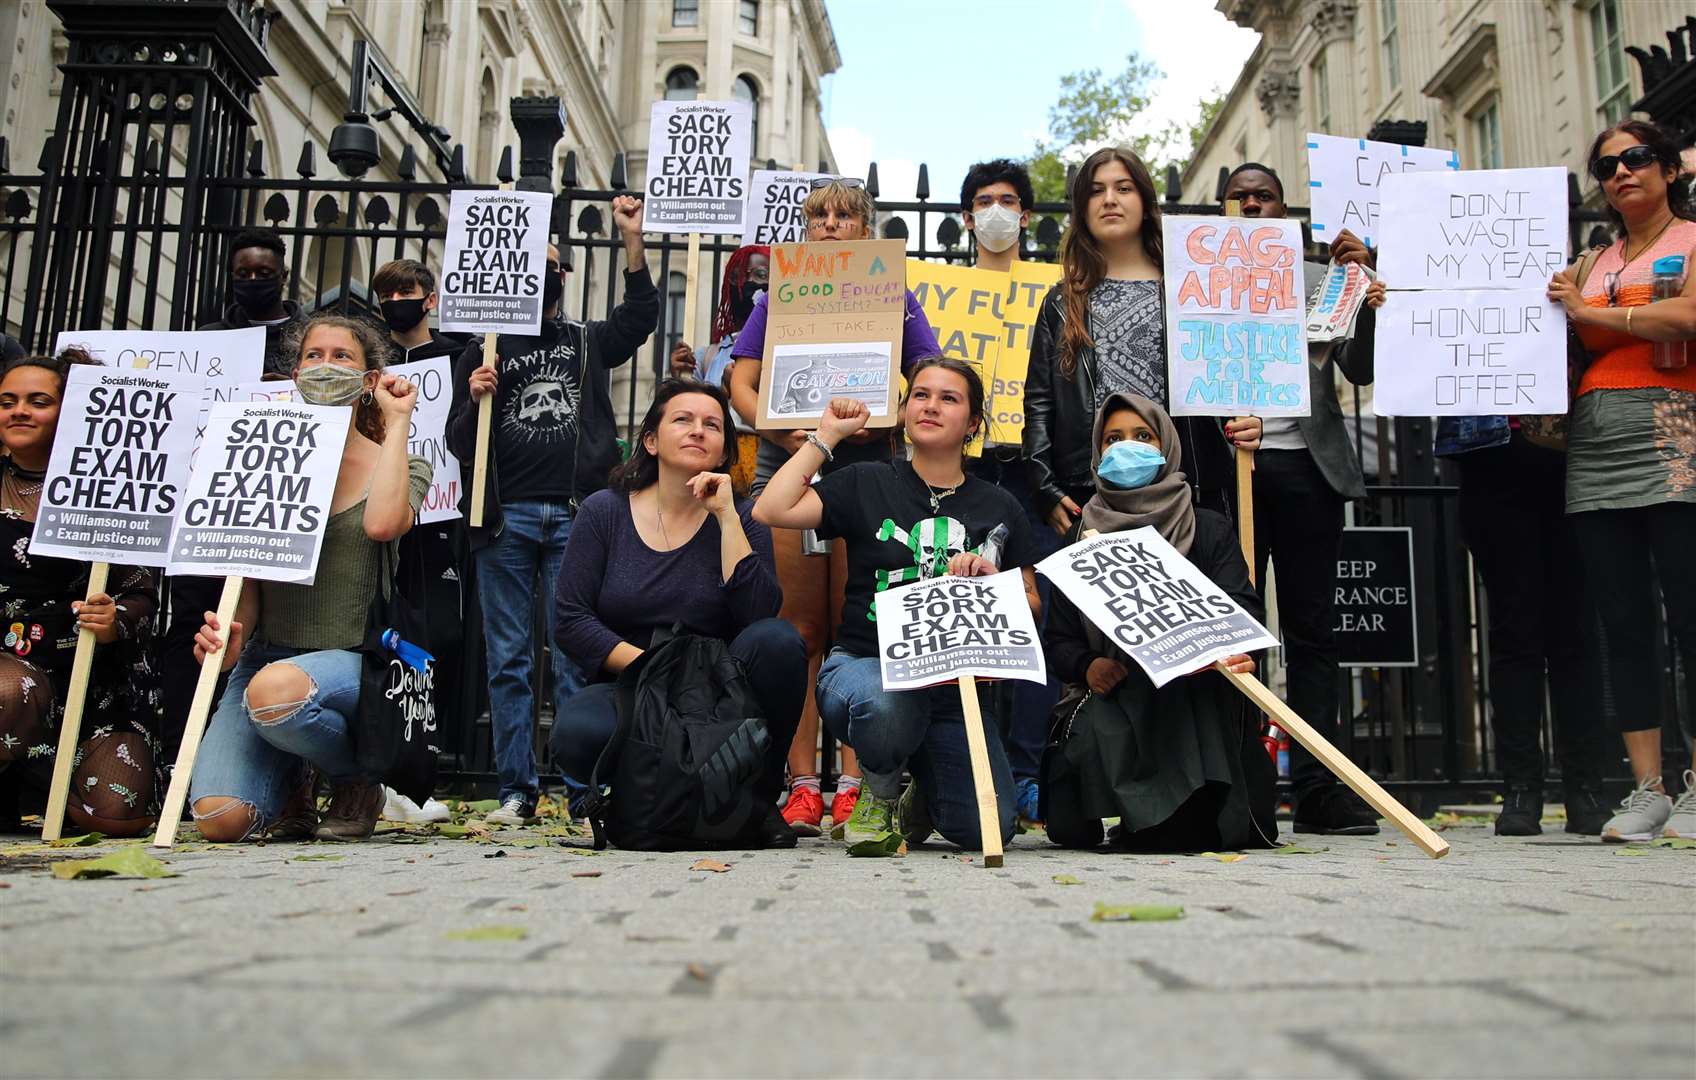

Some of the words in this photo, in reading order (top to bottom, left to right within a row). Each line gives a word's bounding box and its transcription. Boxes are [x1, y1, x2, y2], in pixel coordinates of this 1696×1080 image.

[667, 114, 732, 135] SACK
[668, 135, 730, 155] TORY
[662, 156, 732, 176] EXAM
[649, 177, 743, 198] CHEATS
[765, 185, 808, 205] SAC
[474, 196, 501, 204] Socialist
[501, 196, 525, 204] Worker
[660, 201, 709, 210] Williamson
[710, 202, 726, 210] out
[1450, 190, 1530, 218] DON'T
[465, 205, 531, 227] SACK
[660, 211, 684, 220] Exam
[685, 211, 716, 221] justice
[763, 205, 802, 226] TOR
[465, 227, 528, 249] TORY
[1440, 218, 1550, 248] WASTE
[458, 250, 529, 272] EXAM
[775, 246, 854, 279] WANT
[868, 256, 887, 276] A
[1427, 254, 1468, 280] MY
[1481, 252, 1562, 280] YEAR
[445, 272, 539, 296] CHEATS
[778, 283, 833, 303] GOOD
[1178, 266, 1297, 314] APPEAL
[455, 298, 505, 308] Williamson
[505, 300, 521, 308] out
[455, 310, 479, 318] Exam
[479, 310, 511, 320] justice
[512, 312, 531, 320] now
[1412, 306, 1542, 338] HONOUR
[776, 323, 816, 340] JUST
[1179, 320, 1302, 364] JUSTICE
[1445, 343, 1507, 367] THE
[206, 357, 223, 377] &
[1207, 360, 1265, 384] FOR
[101, 375, 137, 387] Socialist
[137, 378, 170, 389] Worker
[1185, 377, 1301, 407] MEDICS
[1436, 374, 1536, 405] OFFER
[85, 387, 177, 421] SACK
[243, 409, 280, 418] Socialist
[281, 409, 314, 419] Worker
[85, 417, 170, 450] TORY
[227, 418, 320, 448] SACK
[69, 447, 168, 482] EXAM
[225, 445, 313, 474] TORY
[48, 476, 177, 513] CHEATS
[207, 472, 311, 503] EXAM
[60, 512, 129, 529] Williamson
[130, 518, 150, 530] out
[184, 499, 320, 532] CHEATS
[57, 528, 91, 541] Exam
[91, 531, 135, 545] justice
[136, 535, 161, 547] now
[196, 532, 266, 545] Williamson
[269, 536, 292, 548] out
[1068, 541, 1104, 560] Socialist
[1103, 536, 1130, 547] Worker
[192, 546, 227, 559] Exam
[228, 546, 274, 561] justice
[276, 553, 304, 563] now
[1070, 542, 1160, 581] SACK
[1088, 560, 1172, 598] TORY
[1336, 560, 1377, 578] EEP
[902, 584, 998, 607] SACK
[910, 580, 949, 591] Socialist
[1334, 587, 1408, 605] RANCE
[905, 599, 997, 621] TORY
[1104, 579, 1202, 622] EXAM
[901, 614, 1009, 641] EXAM
[1113, 595, 1235, 646] CHEATS
[886, 630, 1032, 660] CHEATS
[1151, 627, 1209, 654] Williamson
[1210, 620, 1233, 632] out
[1162, 646, 1195, 663] Exam
[1193, 633, 1232, 651] justice
[1233, 627, 1255, 640] now
[907, 649, 985, 668] Williamson
[986, 648, 1010, 656] out
[910, 664, 947, 677] Exam
[949, 656, 997, 670] justice
[1000, 658, 1029, 666] now
